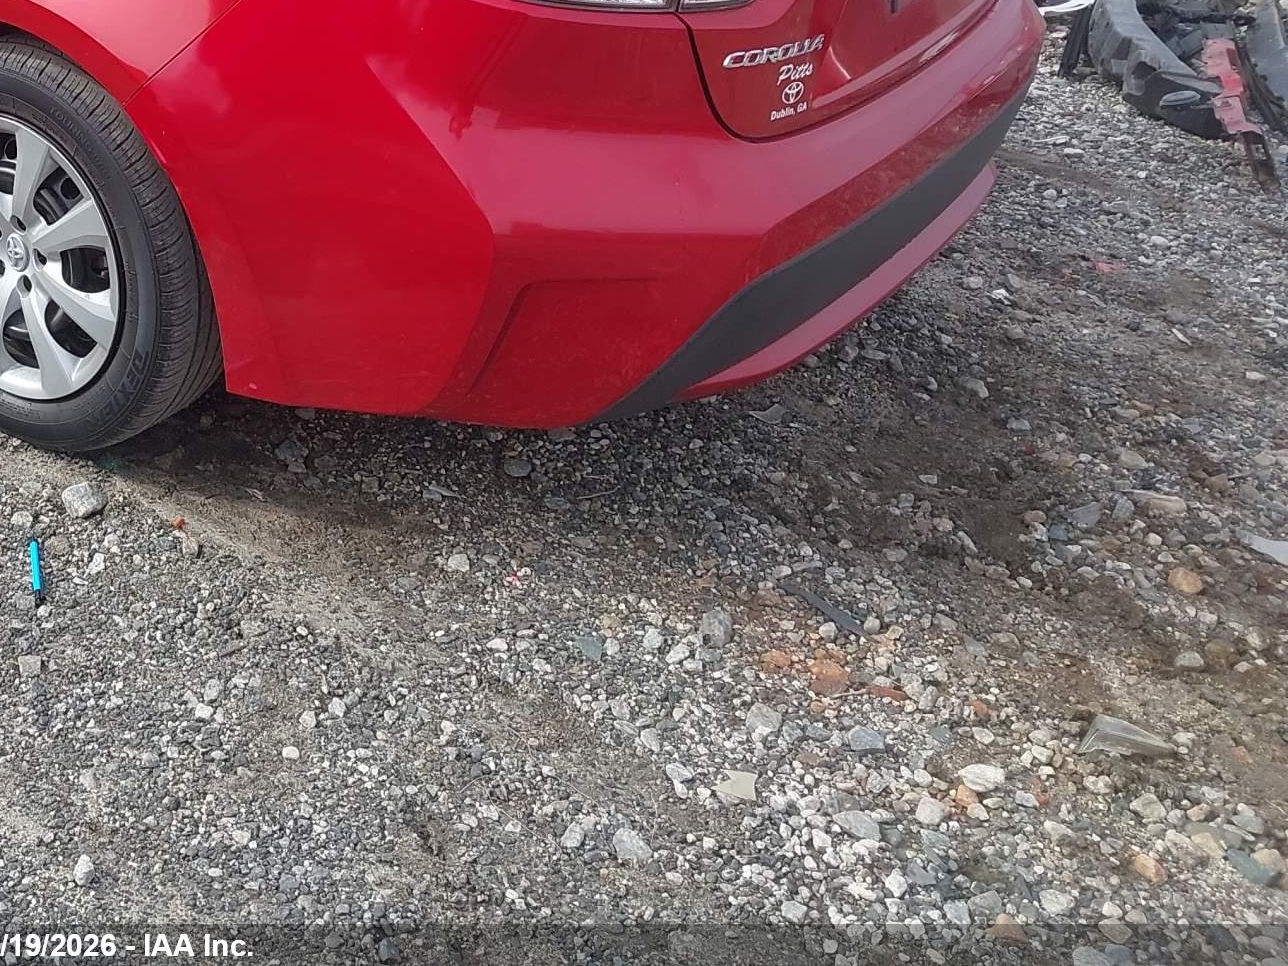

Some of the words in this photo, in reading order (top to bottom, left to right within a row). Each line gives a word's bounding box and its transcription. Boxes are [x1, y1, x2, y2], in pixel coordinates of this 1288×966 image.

[722, 34, 825, 68] COROLLA
[776, 62, 813, 86] Pitts
[770, 107, 796, 121] Dublin,
[797, 102, 808, 113] GA
